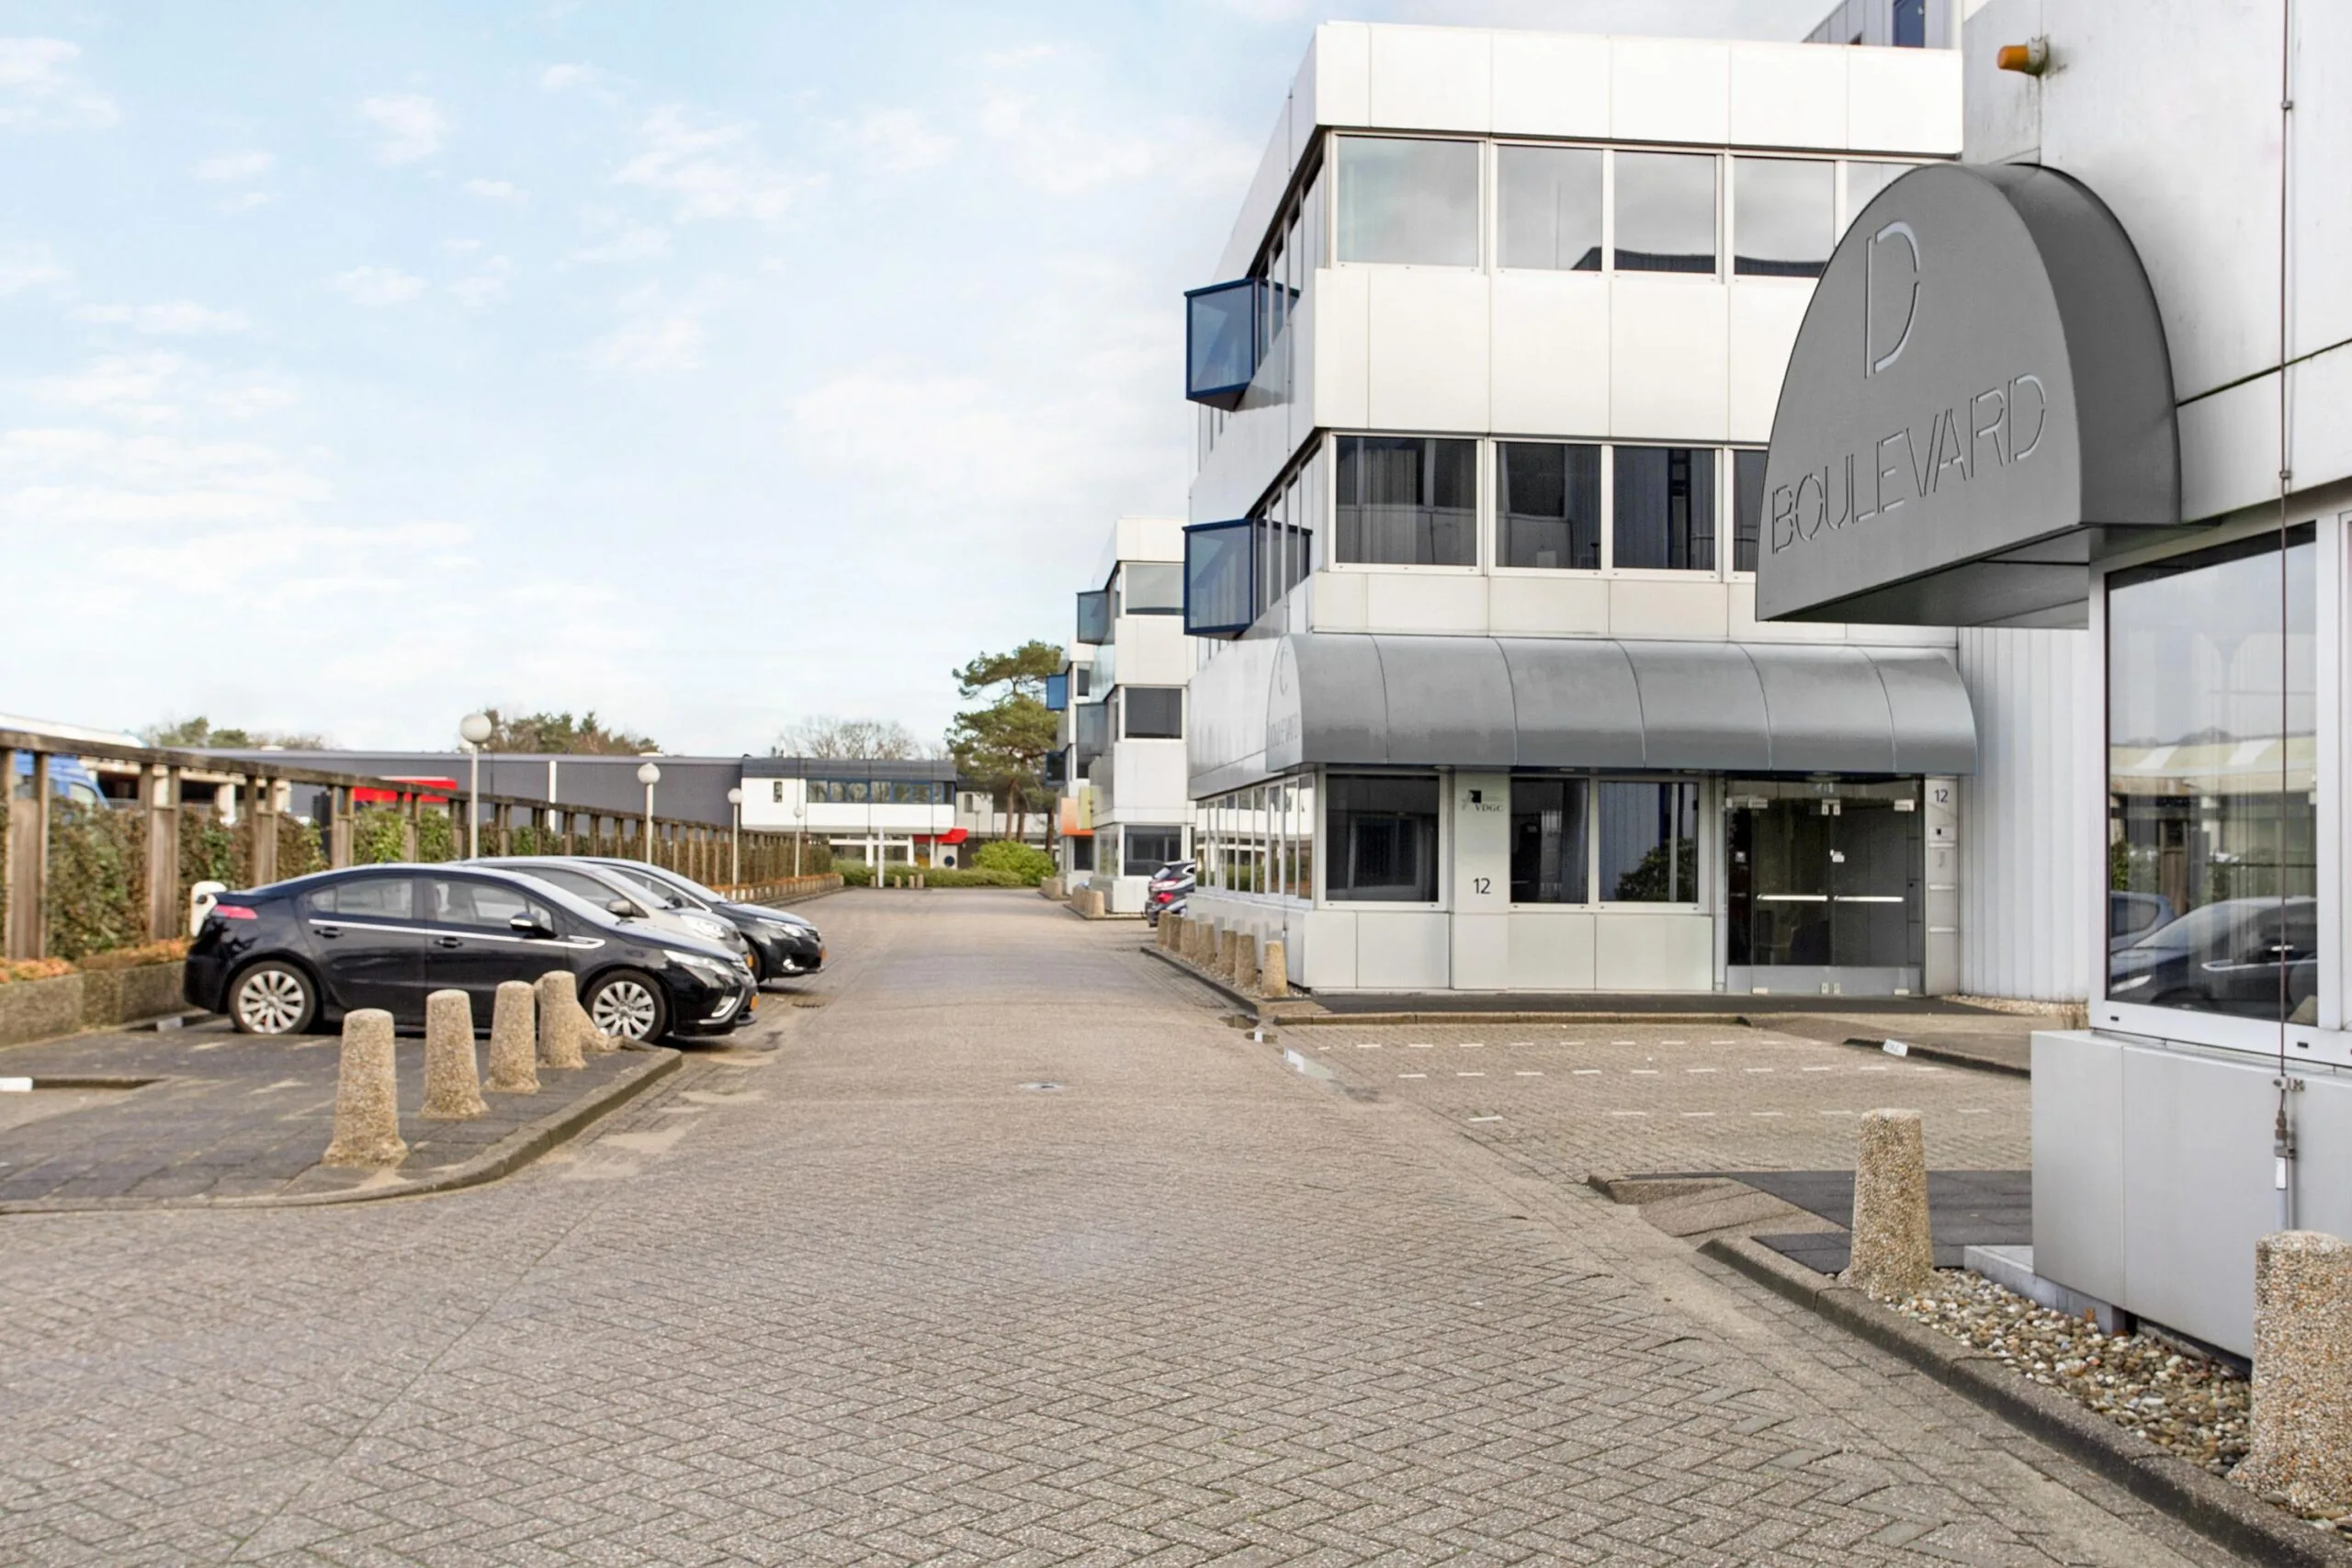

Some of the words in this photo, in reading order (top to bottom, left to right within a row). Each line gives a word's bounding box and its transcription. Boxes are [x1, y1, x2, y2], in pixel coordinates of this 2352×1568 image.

[1866, 221, 1919, 378] D
[1772, 374, 2046, 554] BOULEVARD
[1934, 789, 1949, 804] 12
[1473, 877, 1491, 894] 12
